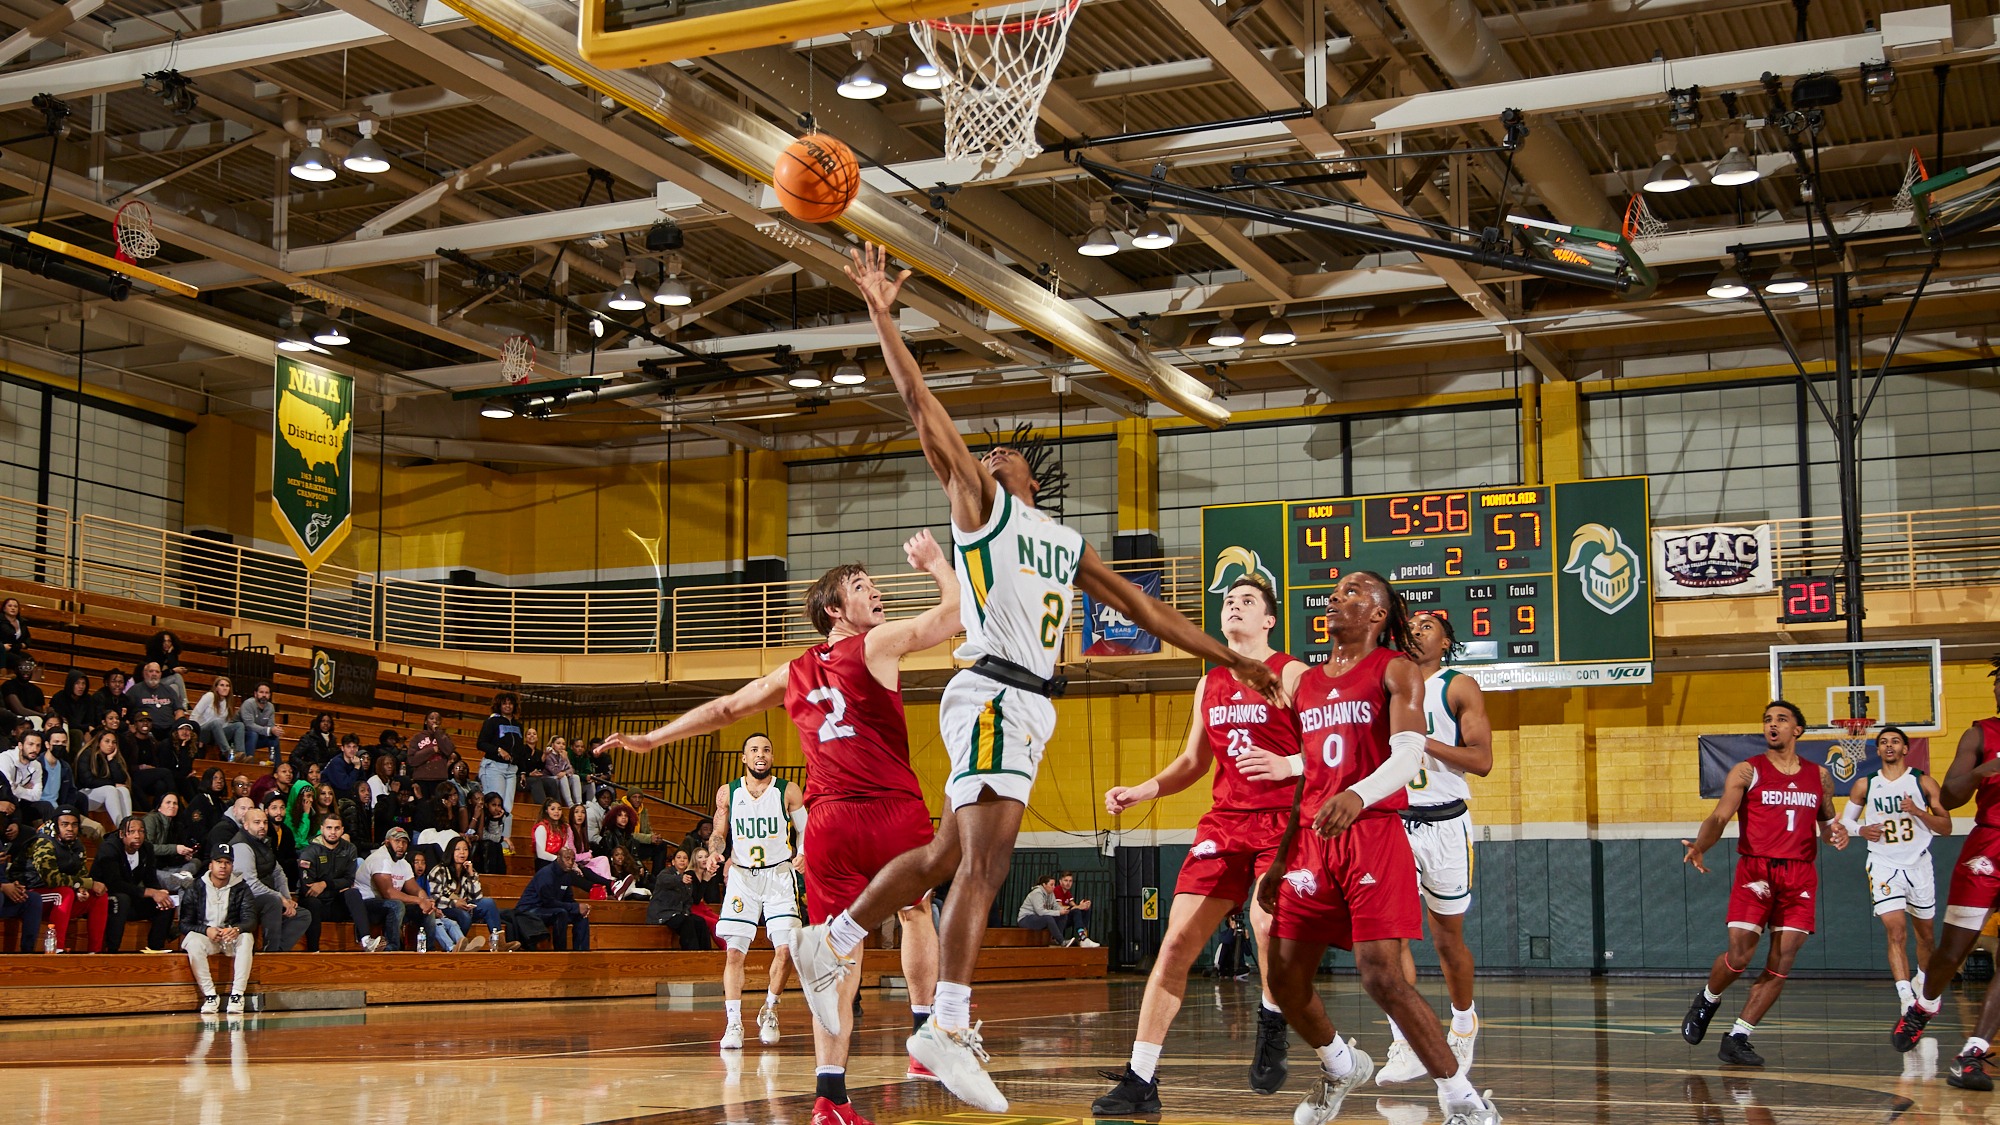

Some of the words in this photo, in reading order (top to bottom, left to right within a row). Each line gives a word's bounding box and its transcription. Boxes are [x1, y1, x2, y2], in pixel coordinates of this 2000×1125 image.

[288, 366, 340, 403] NAIA
[288, 423, 326, 444] District
[329, 434, 338, 448] 31
[296, 489, 328, 502] CHAMPIONS
[304, 482, 337, 495] BASKETBALL
[1481, 491, 1537, 507] MONTCLAIR
[1308, 505, 1333, 518] NJCU
[1389, 494, 1468, 534] 5:56
[1305, 525, 1350, 560] 41
[1493, 512, 1541, 551] 57
[1445, 547, 1462, 575] 2
[1667, 533, 1757, 567] ECAC
[1400, 563, 1433, 579] period
[1306, 596, 1330, 608] fouls
[1510, 585, 1535, 597] fouls
[1788, 582, 1830, 615] 26
[1040, 591, 1064, 650] 2
[1313, 616, 1330, 643] 9
[1472, 607, 1491, 636] 6
[1517, 605, 1535, 634] 9
[1513, 645, 1533, 654] won
[337, 663, 373, 681] GREEN
[1607, 666, 1646, 680] NJCU
[339, 680, 370, 696] ARMY
[806, 686, 858, 744] 2
[1227, 728, 1252, 757] 23
[1323, 733, 1343, 768] 0
[1874, 796, 1912, 815] NJC
[736, 817, 778, 839] NJCU
[1786, 809, 1795, 832] 1
[1883, 818, 1914, 845] 23
[749, 845, 766, 868] 3
